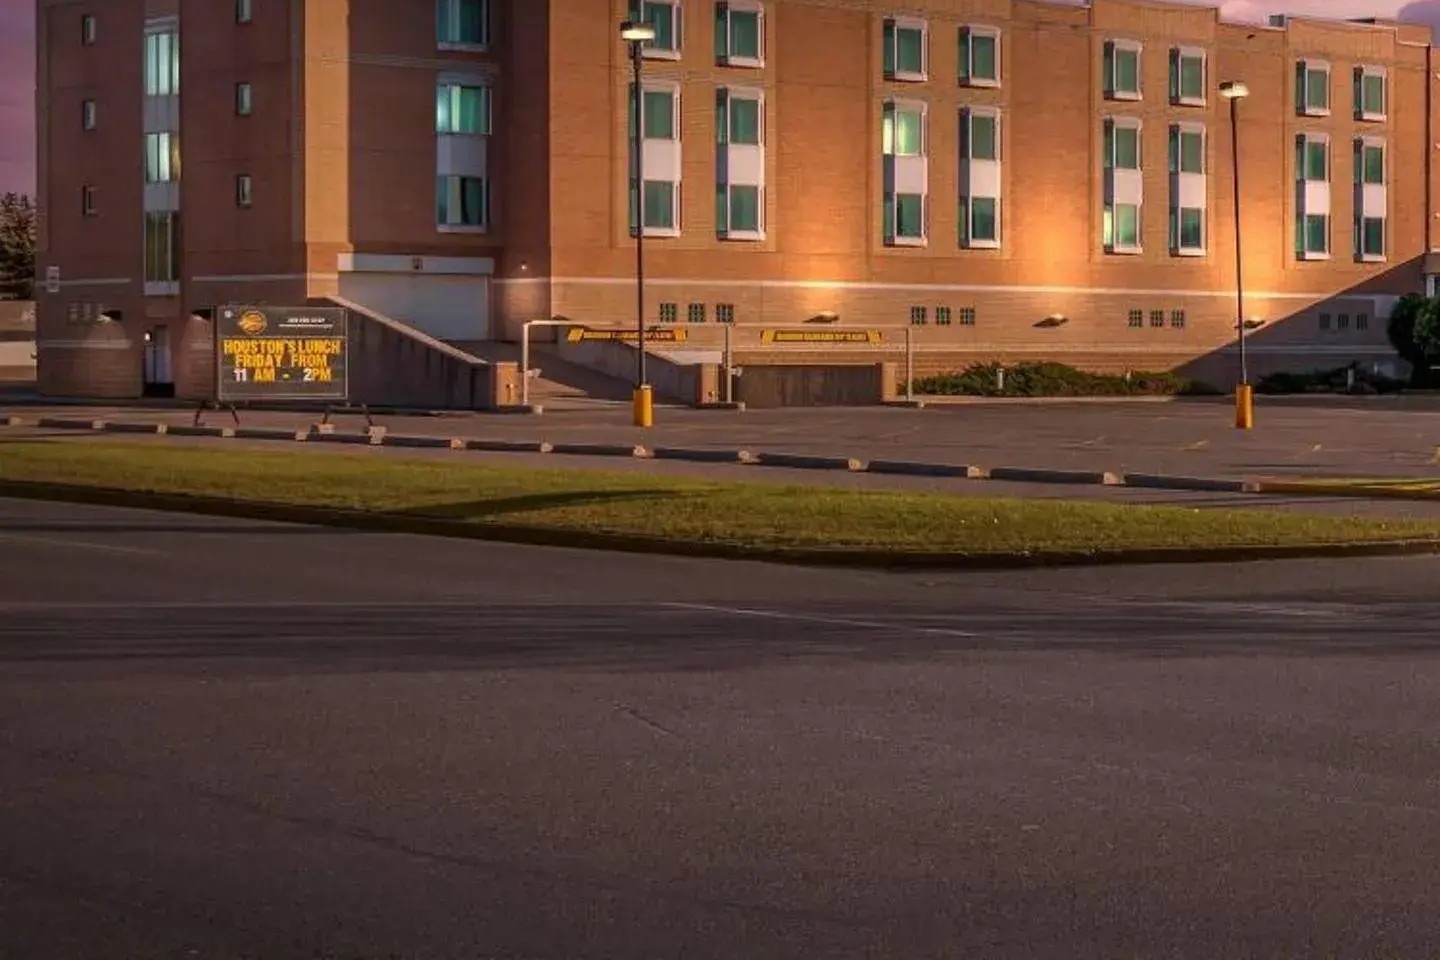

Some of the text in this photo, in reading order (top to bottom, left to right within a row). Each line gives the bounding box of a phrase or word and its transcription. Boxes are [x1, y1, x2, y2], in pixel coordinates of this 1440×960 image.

[224, 339, 341, 354] HOUSTON'S LUNCH
[235, 354, 327, 367] FRIDAY FROM
[234, 368, 247, 382] 11
[254, 368, 276, 382] AM
[303, 368, 332, 382] 2PM
